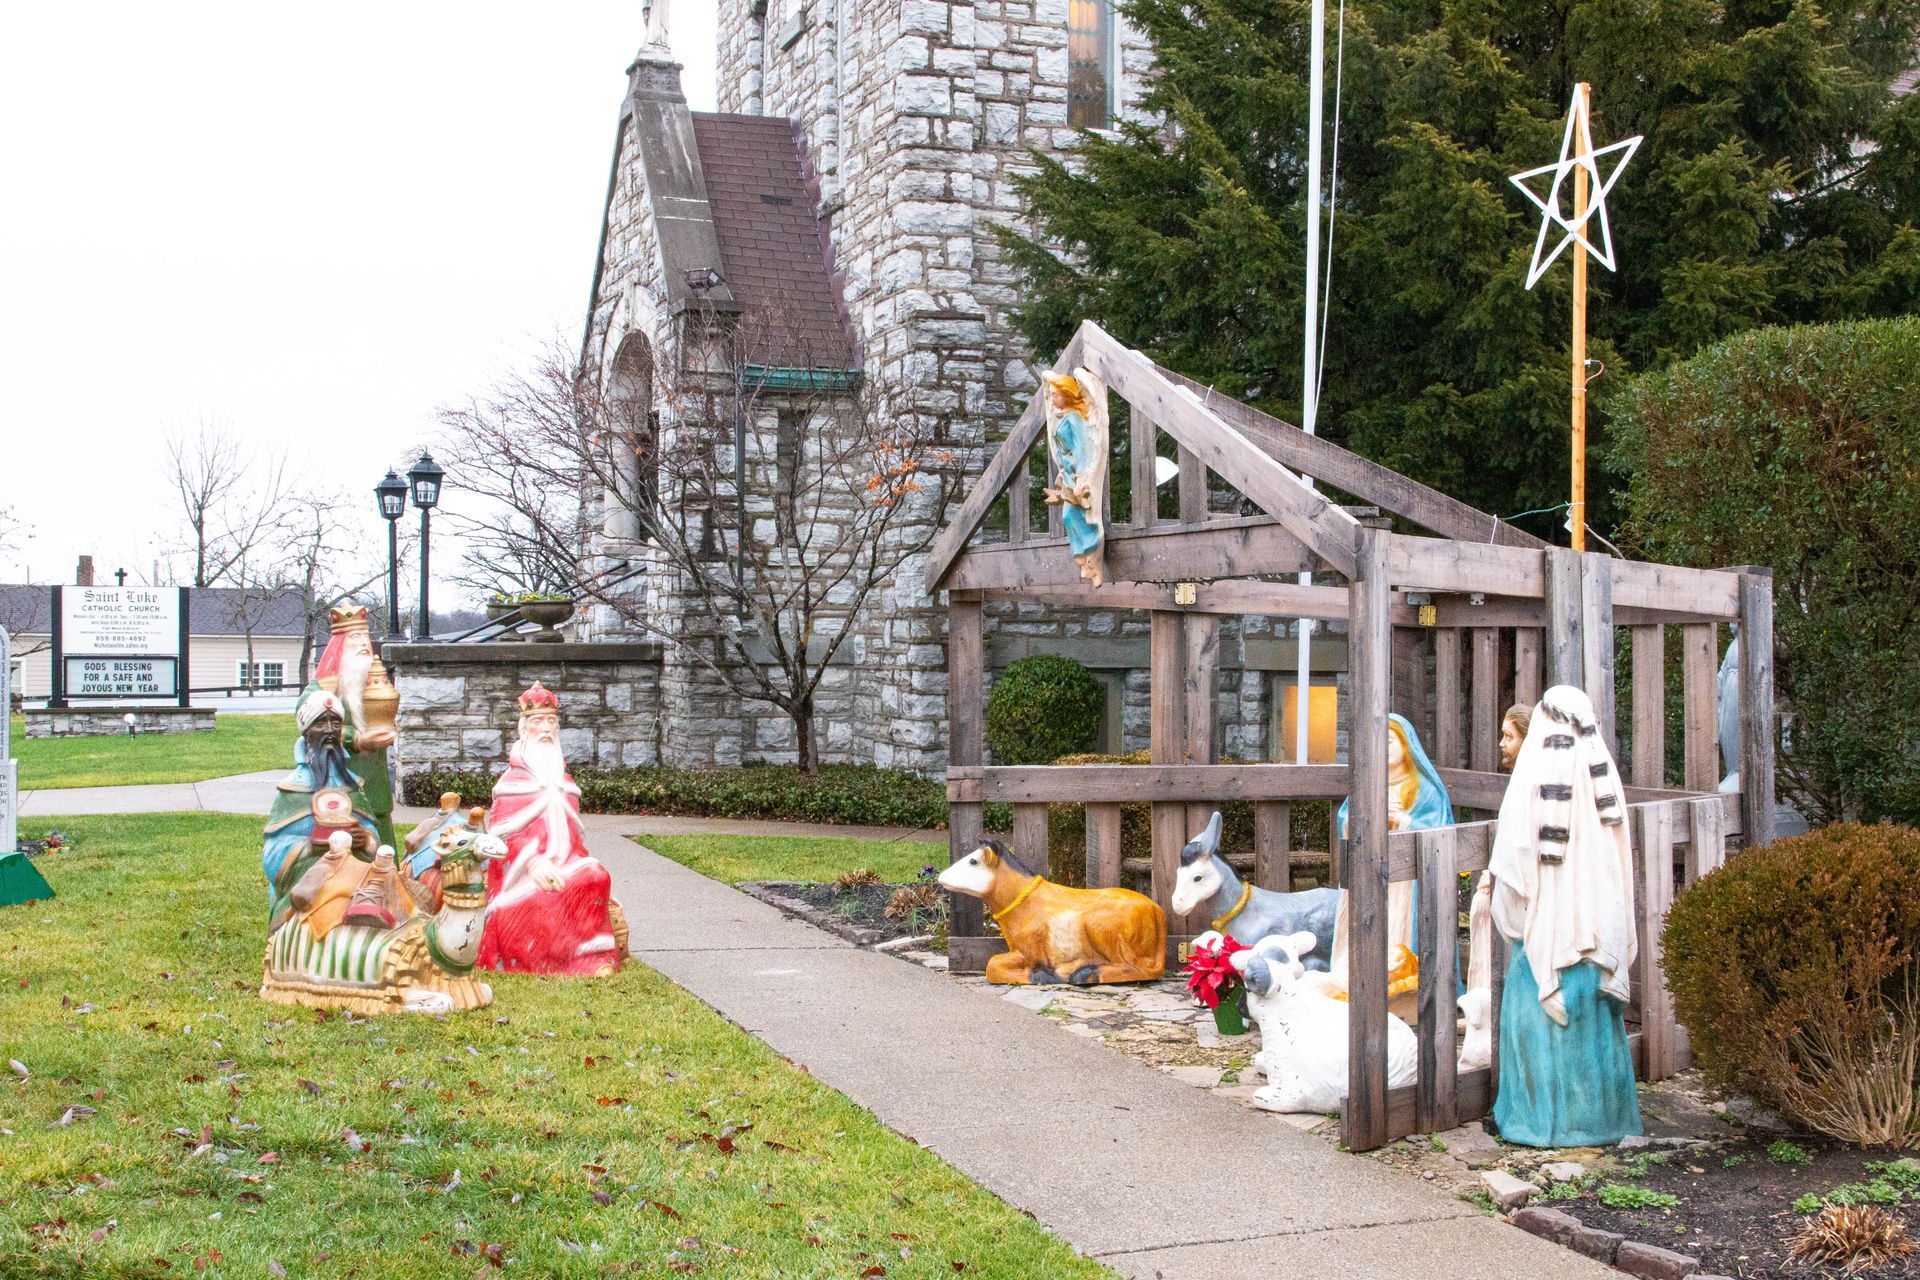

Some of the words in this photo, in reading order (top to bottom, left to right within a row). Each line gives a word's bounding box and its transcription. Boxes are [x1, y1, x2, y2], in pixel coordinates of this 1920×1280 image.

[84, 590, 119, 602] Saint
[126, 590, 158, 603] Luke
[84, 662, 106, 671] GODS
[114, 662, 152, 671] BLESSING
[84, 674, 100, 682] FOR
[104, 674, 110, 682] A
[112, 674, 132, 682] SAFE
[136, 674, 152, 682] AND
[81, 684, 112, 692] JOYOUS
[116, 684, 132, 692] NEW
[138, 684, 158, 692] YEAR
